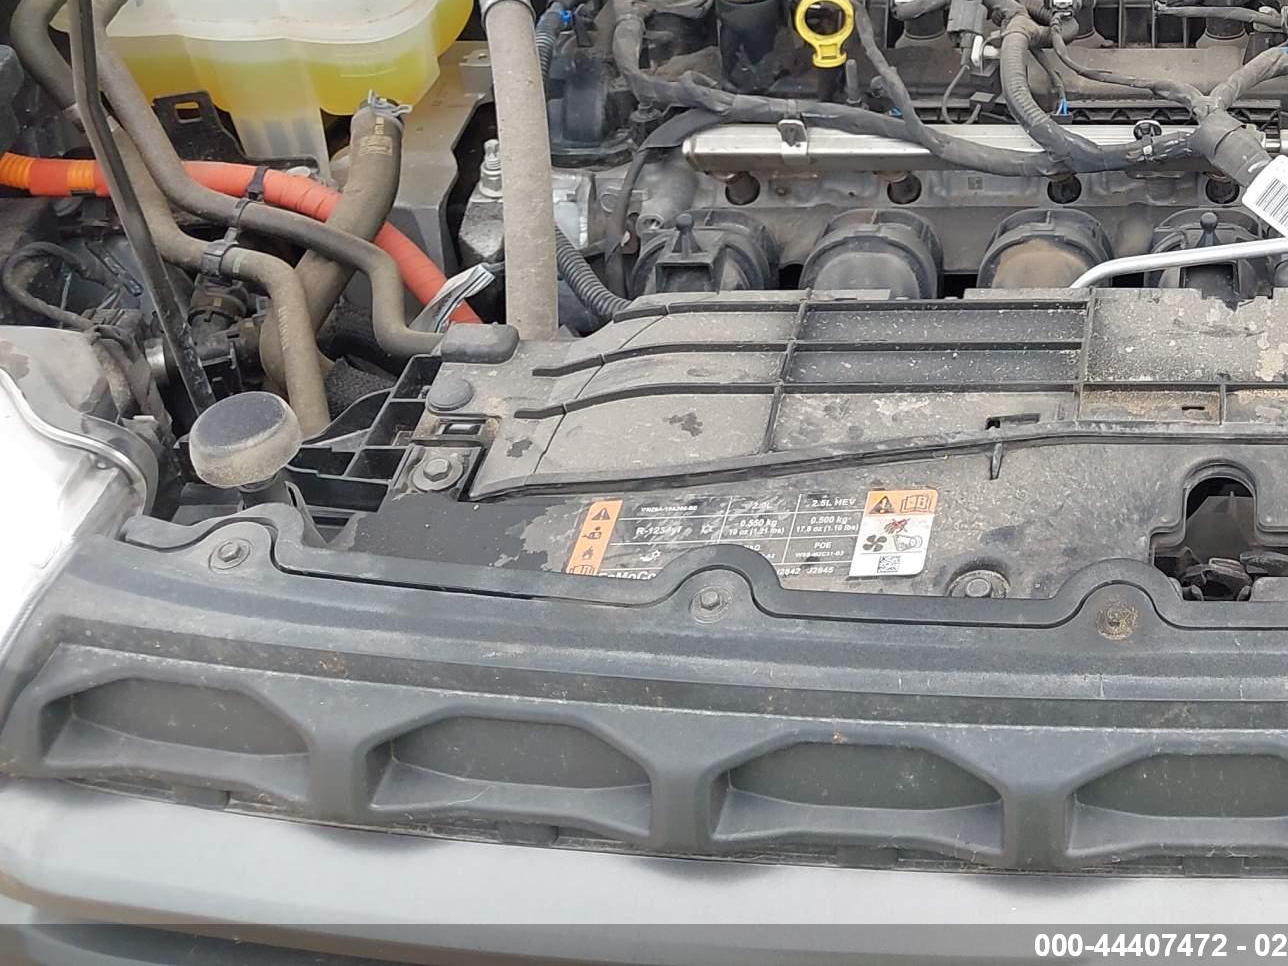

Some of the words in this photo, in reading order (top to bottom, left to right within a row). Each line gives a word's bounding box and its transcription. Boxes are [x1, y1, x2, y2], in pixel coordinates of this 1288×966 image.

[811, 498, 833, 507] 2.5L
[834, 497, 857, 507] HEV
[810, 515, 835, 524] 0.500
